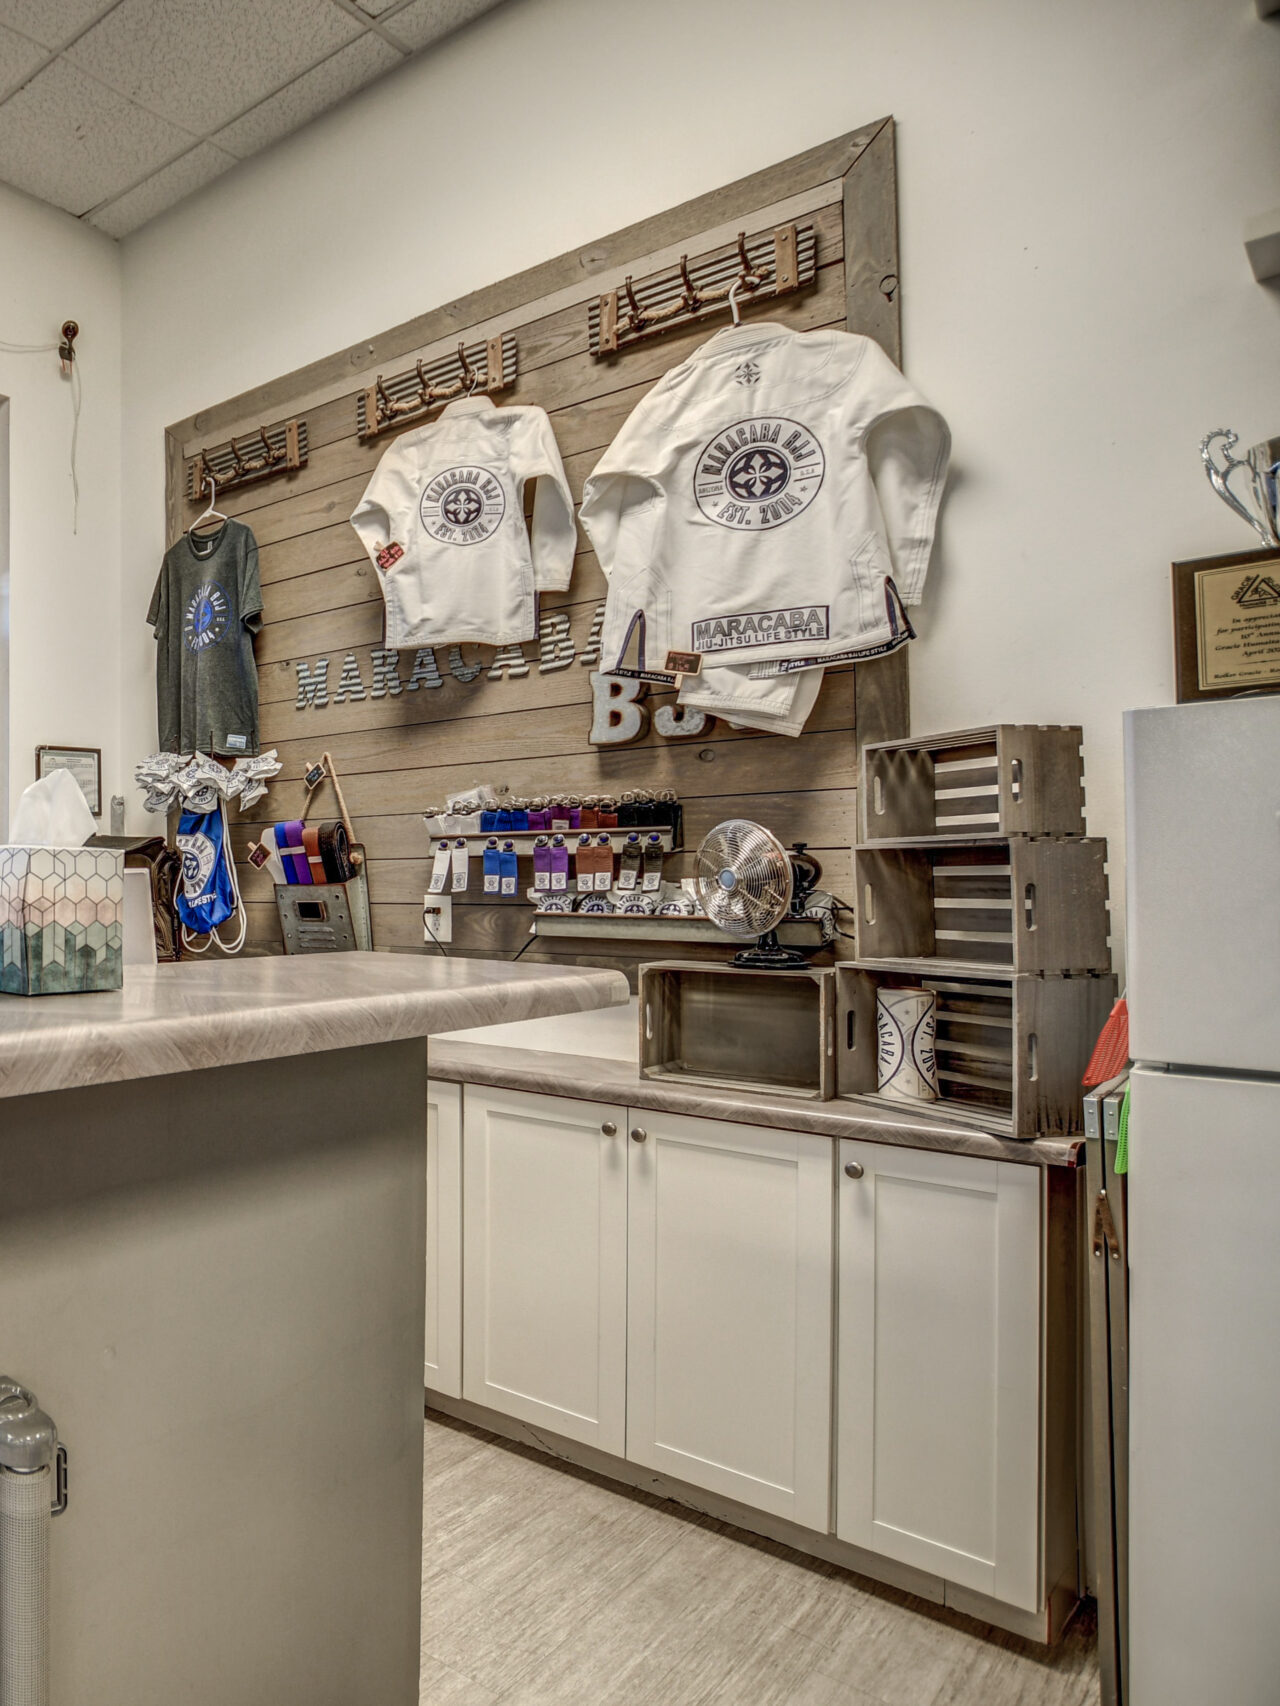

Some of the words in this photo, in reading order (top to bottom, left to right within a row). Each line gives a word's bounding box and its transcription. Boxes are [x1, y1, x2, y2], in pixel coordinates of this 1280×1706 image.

[701, 423, 781, 476] MARACABA
[782, 430, 816, 462] BJJ
[717, 501, 751, 525] EST.
[760, 492, 803, 524] 2004
[210, 591, 226, 611] BJJ
[695, 609, 823, 642] MARACABA
[696, 635, 751, 651] JIU-JITSU
[755, 631, 781, 643] LIFE
[783, 626, 825, 640] STYLE
